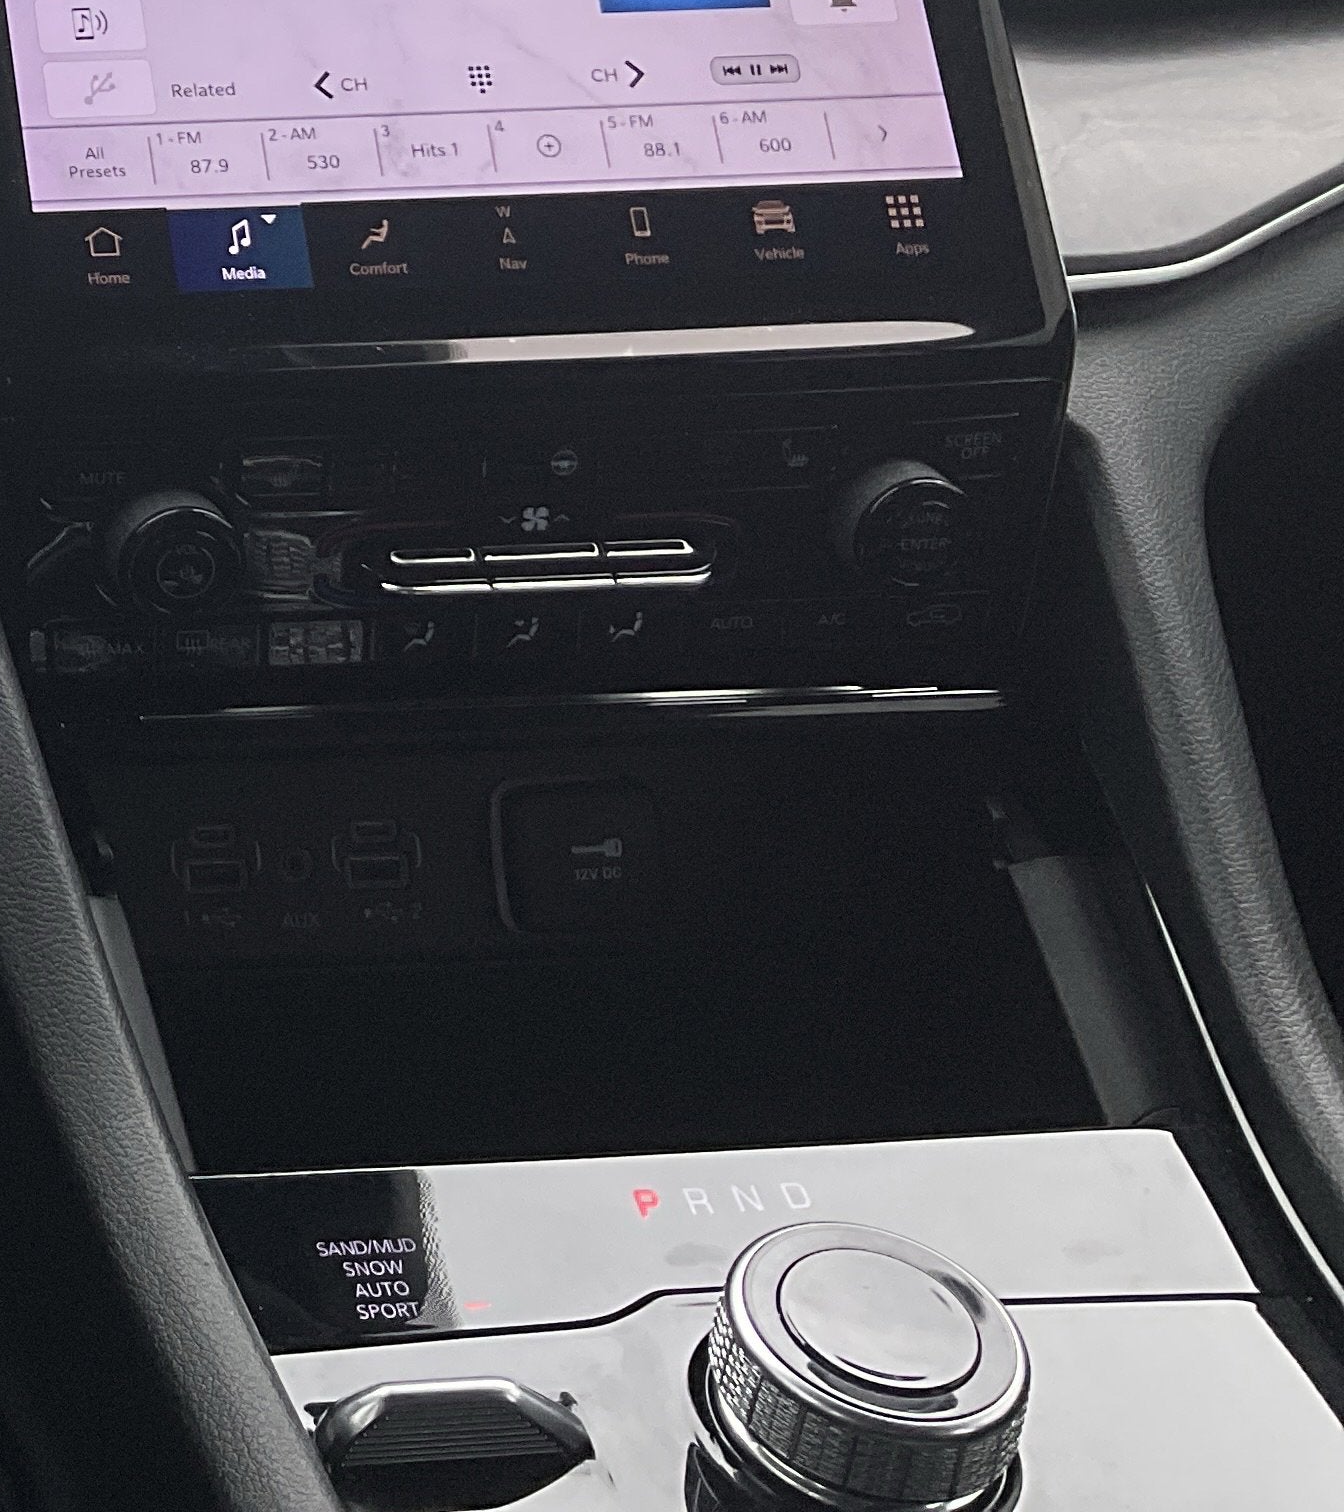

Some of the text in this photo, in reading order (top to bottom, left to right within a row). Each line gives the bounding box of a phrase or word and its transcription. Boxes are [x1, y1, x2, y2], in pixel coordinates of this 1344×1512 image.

[590, 68, 618, 84] CH
[170, 82, 236, 98] Related
[340, 77, 369, 93] CH
[380, 124, 391, 138] 3
[494, 119, 505, 133] 4
[84, 146, 105, 160] All
[411, 143, 459, 158] Hits 1
[643, 141, 682, 157] 88.1
[759, 137, 792, 153] 600
[190, 158, 230, 174] 87.9
[306, 154, 341, 170] 530
[69, 165, 127, 180] Presets
[496, 205, 511, 218] W
[753, 245, 805, 262] Vehicle
[895, 241, 931, 258] Apps
[499, 256, 528, 272] Nav
[624, 251, 671, 267] Phone
[221, 265, 267, 281] Media
[349, 260, 409, 276] Comfort
[87, 271, 131, 285] Home
[961, 445, 991, 460] OFF
[79, 471, 126, 486] MUTE
[710, 615, 754, 630] AUTO
[817, 612, 846, 626] A/C
[572, 866, 599, 882] 12V
[282, 911, 321, 929] AUX
[632, 1182, 812, 1218] P R N D
[315, 1238, 417, 1258] SAND/MUD
[342, 1259, 404, 1278] SNOW
[355, 1280, 411, 1298] AUTO
[356, 1301, 420, 1320] SPORT
